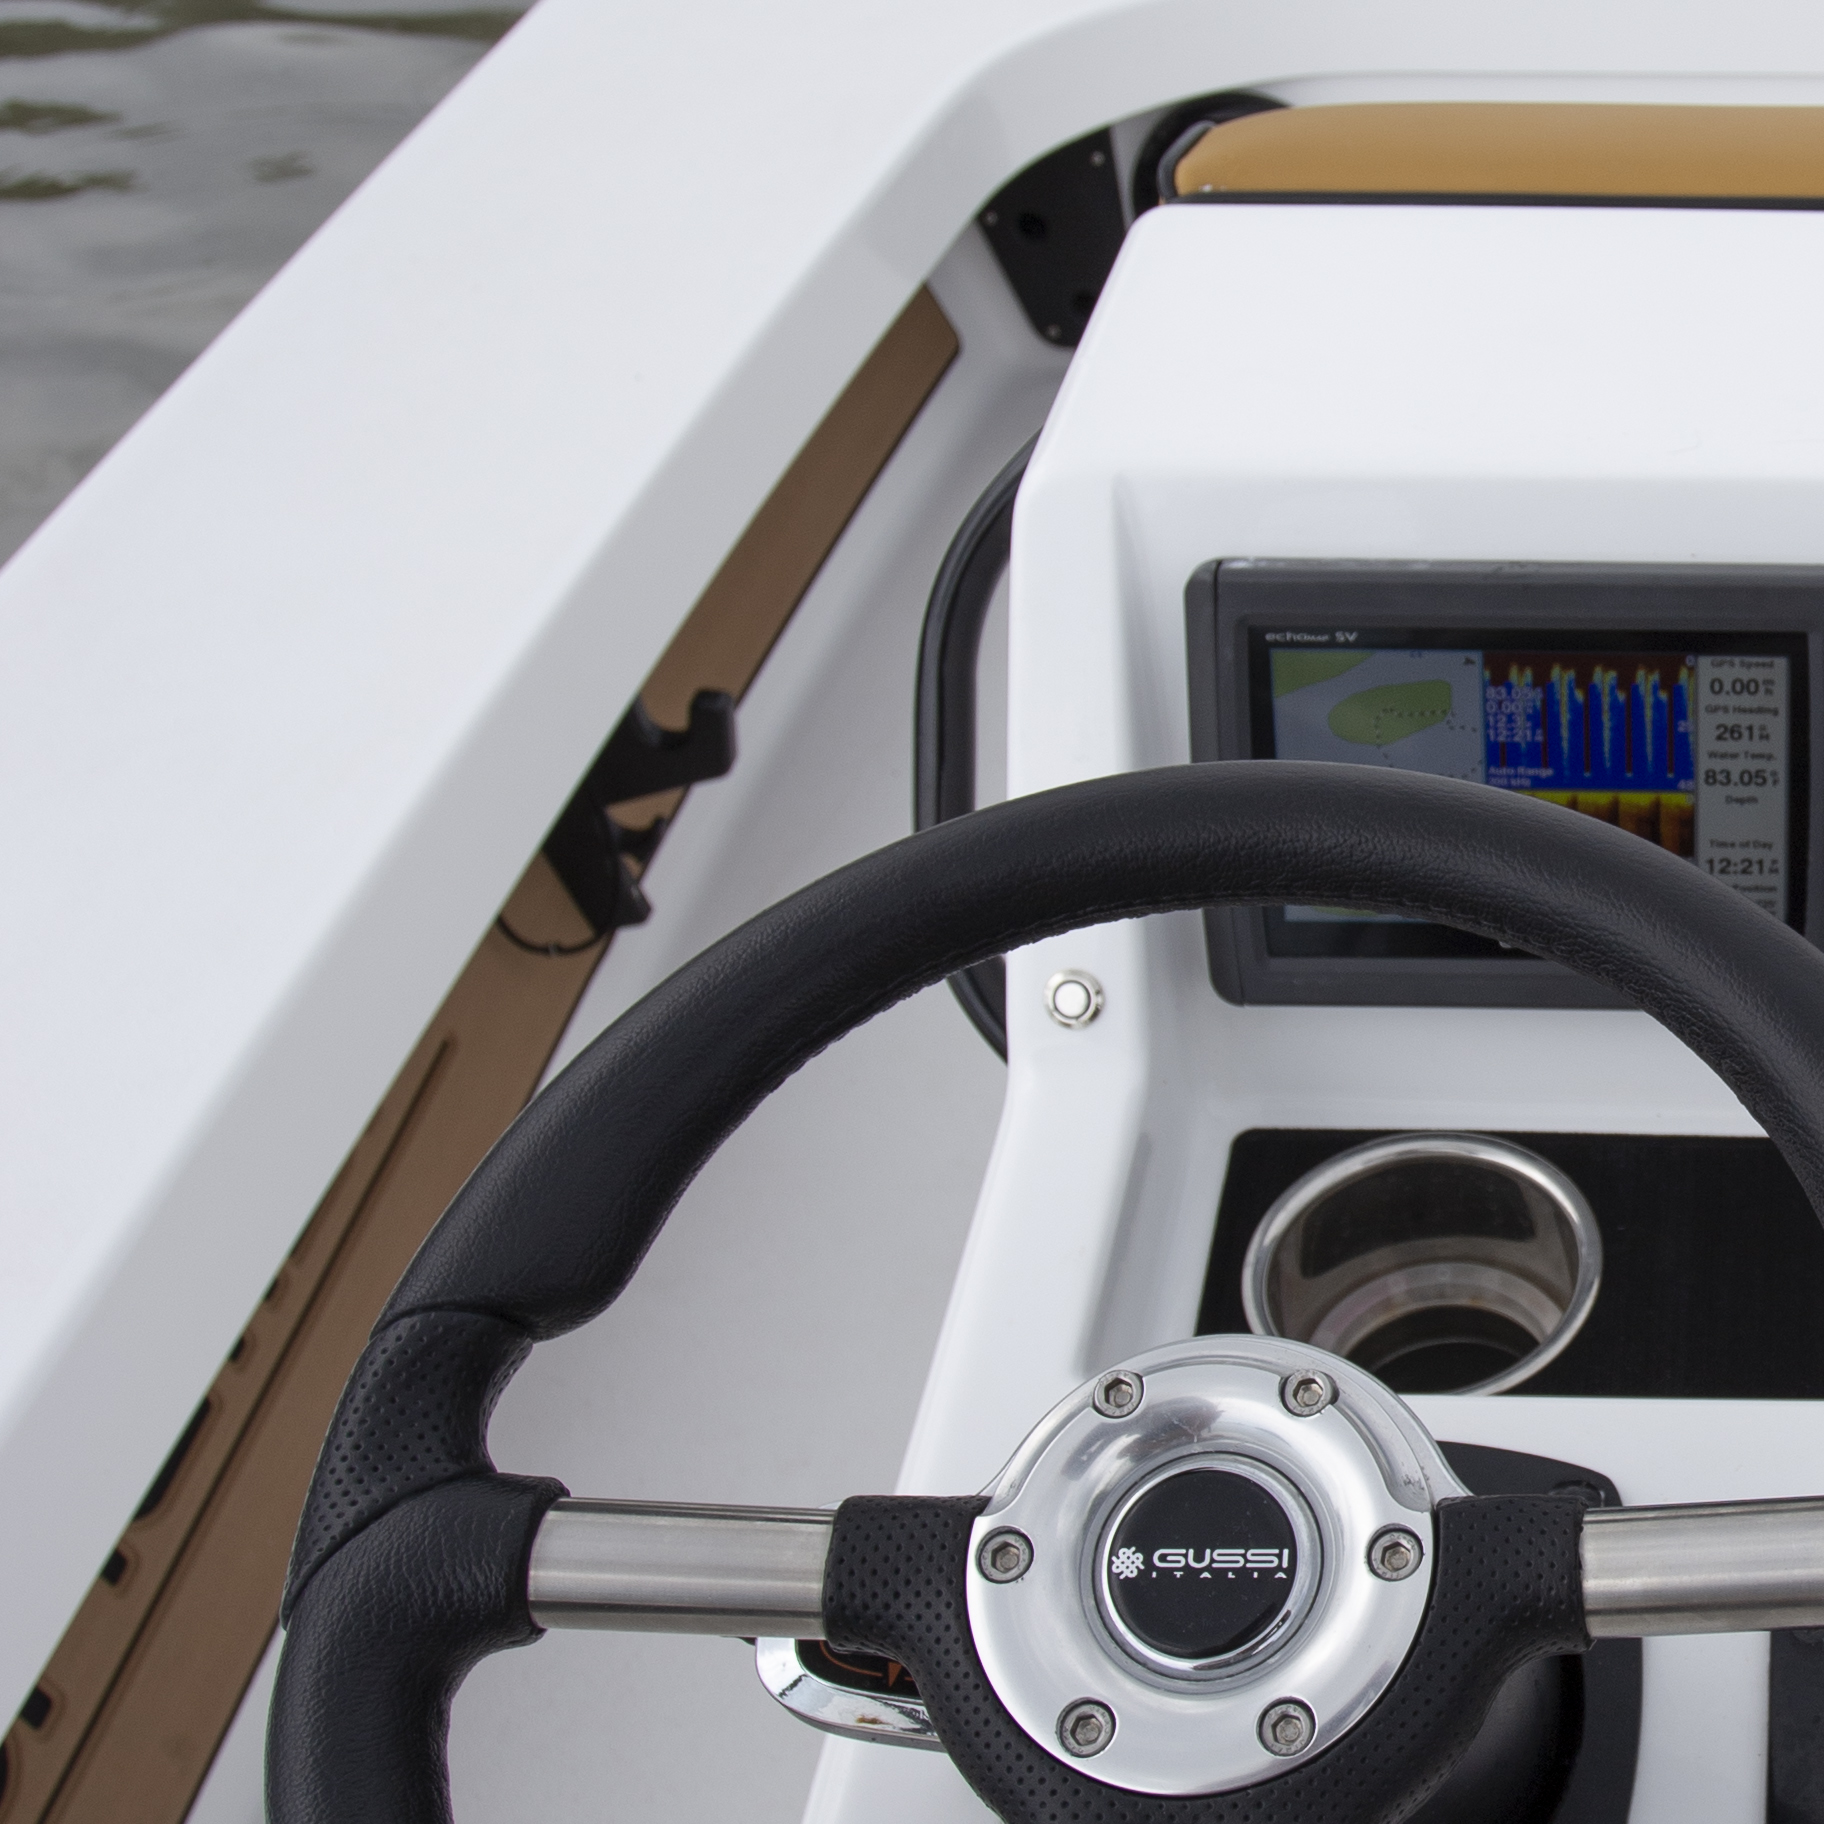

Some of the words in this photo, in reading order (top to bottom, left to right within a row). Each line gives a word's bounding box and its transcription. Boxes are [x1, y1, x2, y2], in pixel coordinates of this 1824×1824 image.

[1709, 678, 1760, 695] 0.00
[1715, 723, 1755, 742] 261
[1703, 768, 1767, 787] 83.05
[1705, 857, 1765, 875] 12:21
[1153, 1548, 1289, 1569] GUSSI
[1151, 1571, 1288, 1579] ITALIA
